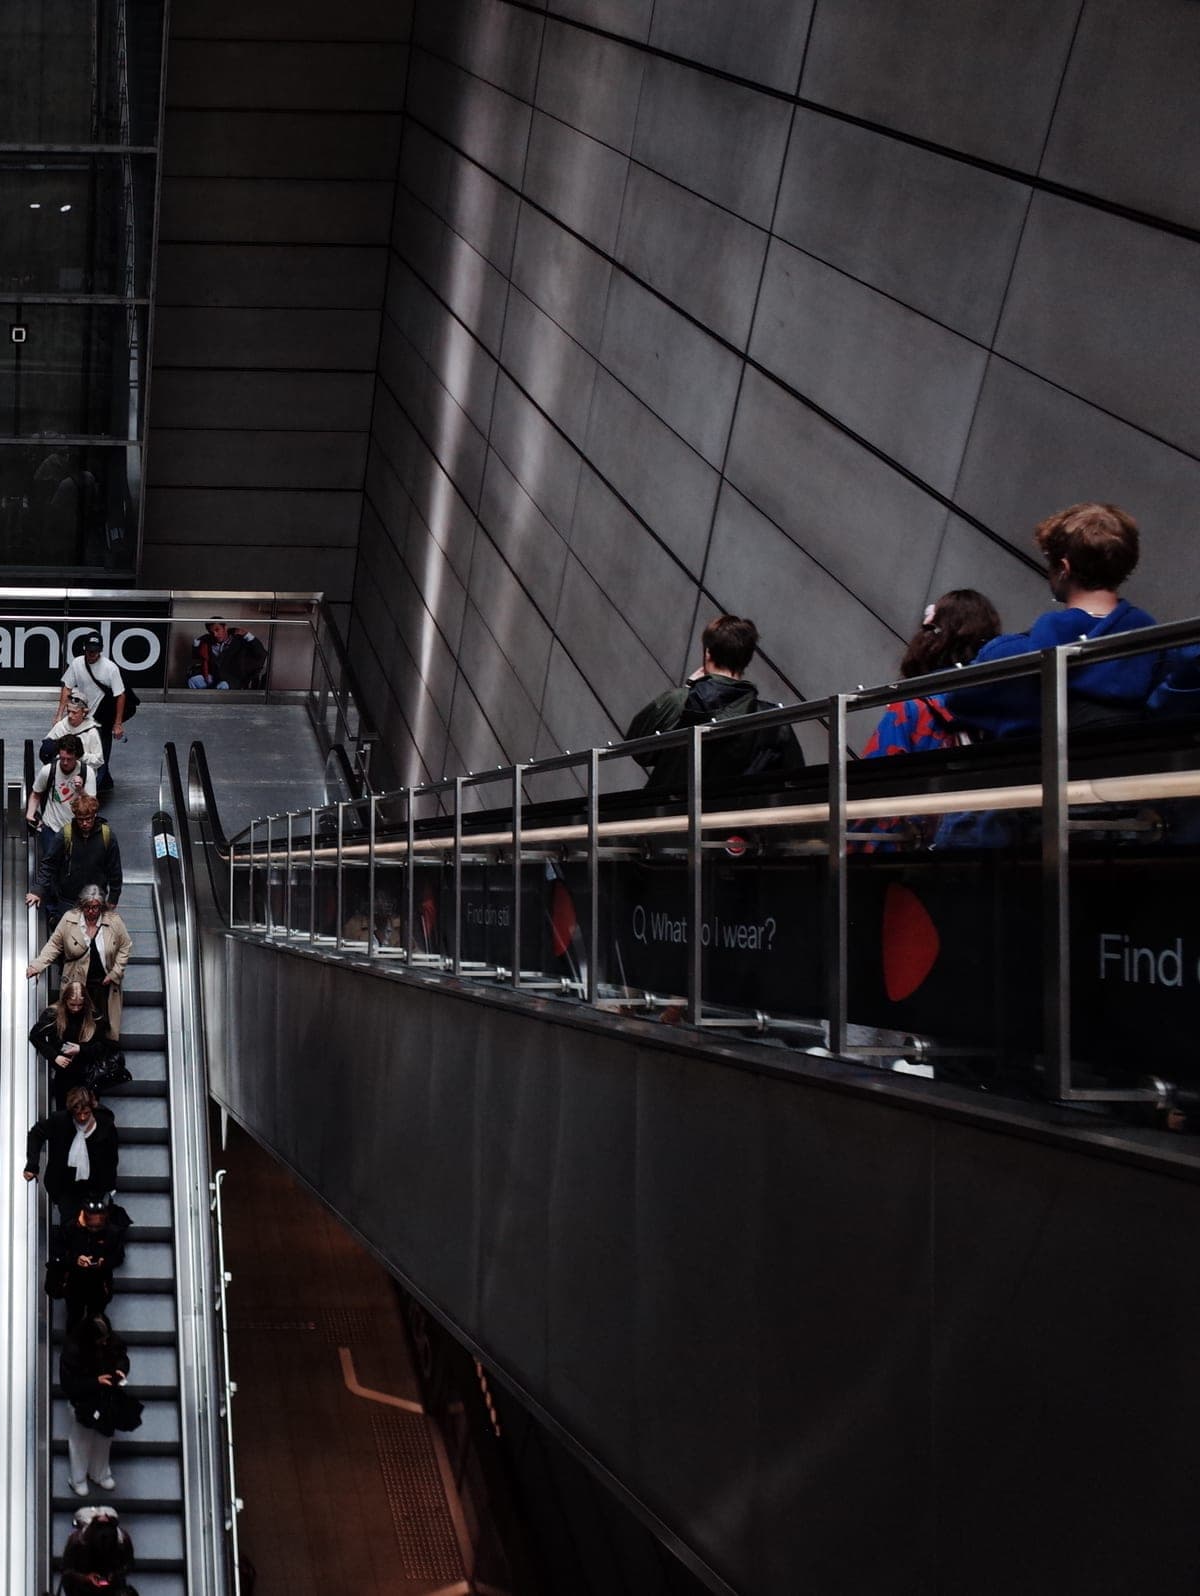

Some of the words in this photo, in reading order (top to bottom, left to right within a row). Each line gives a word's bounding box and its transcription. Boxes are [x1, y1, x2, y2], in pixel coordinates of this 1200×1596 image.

[651, 911, 688, 944] What
[723, 917, 776, 950] wear?
[1099, 933, 1183, 986] Find
